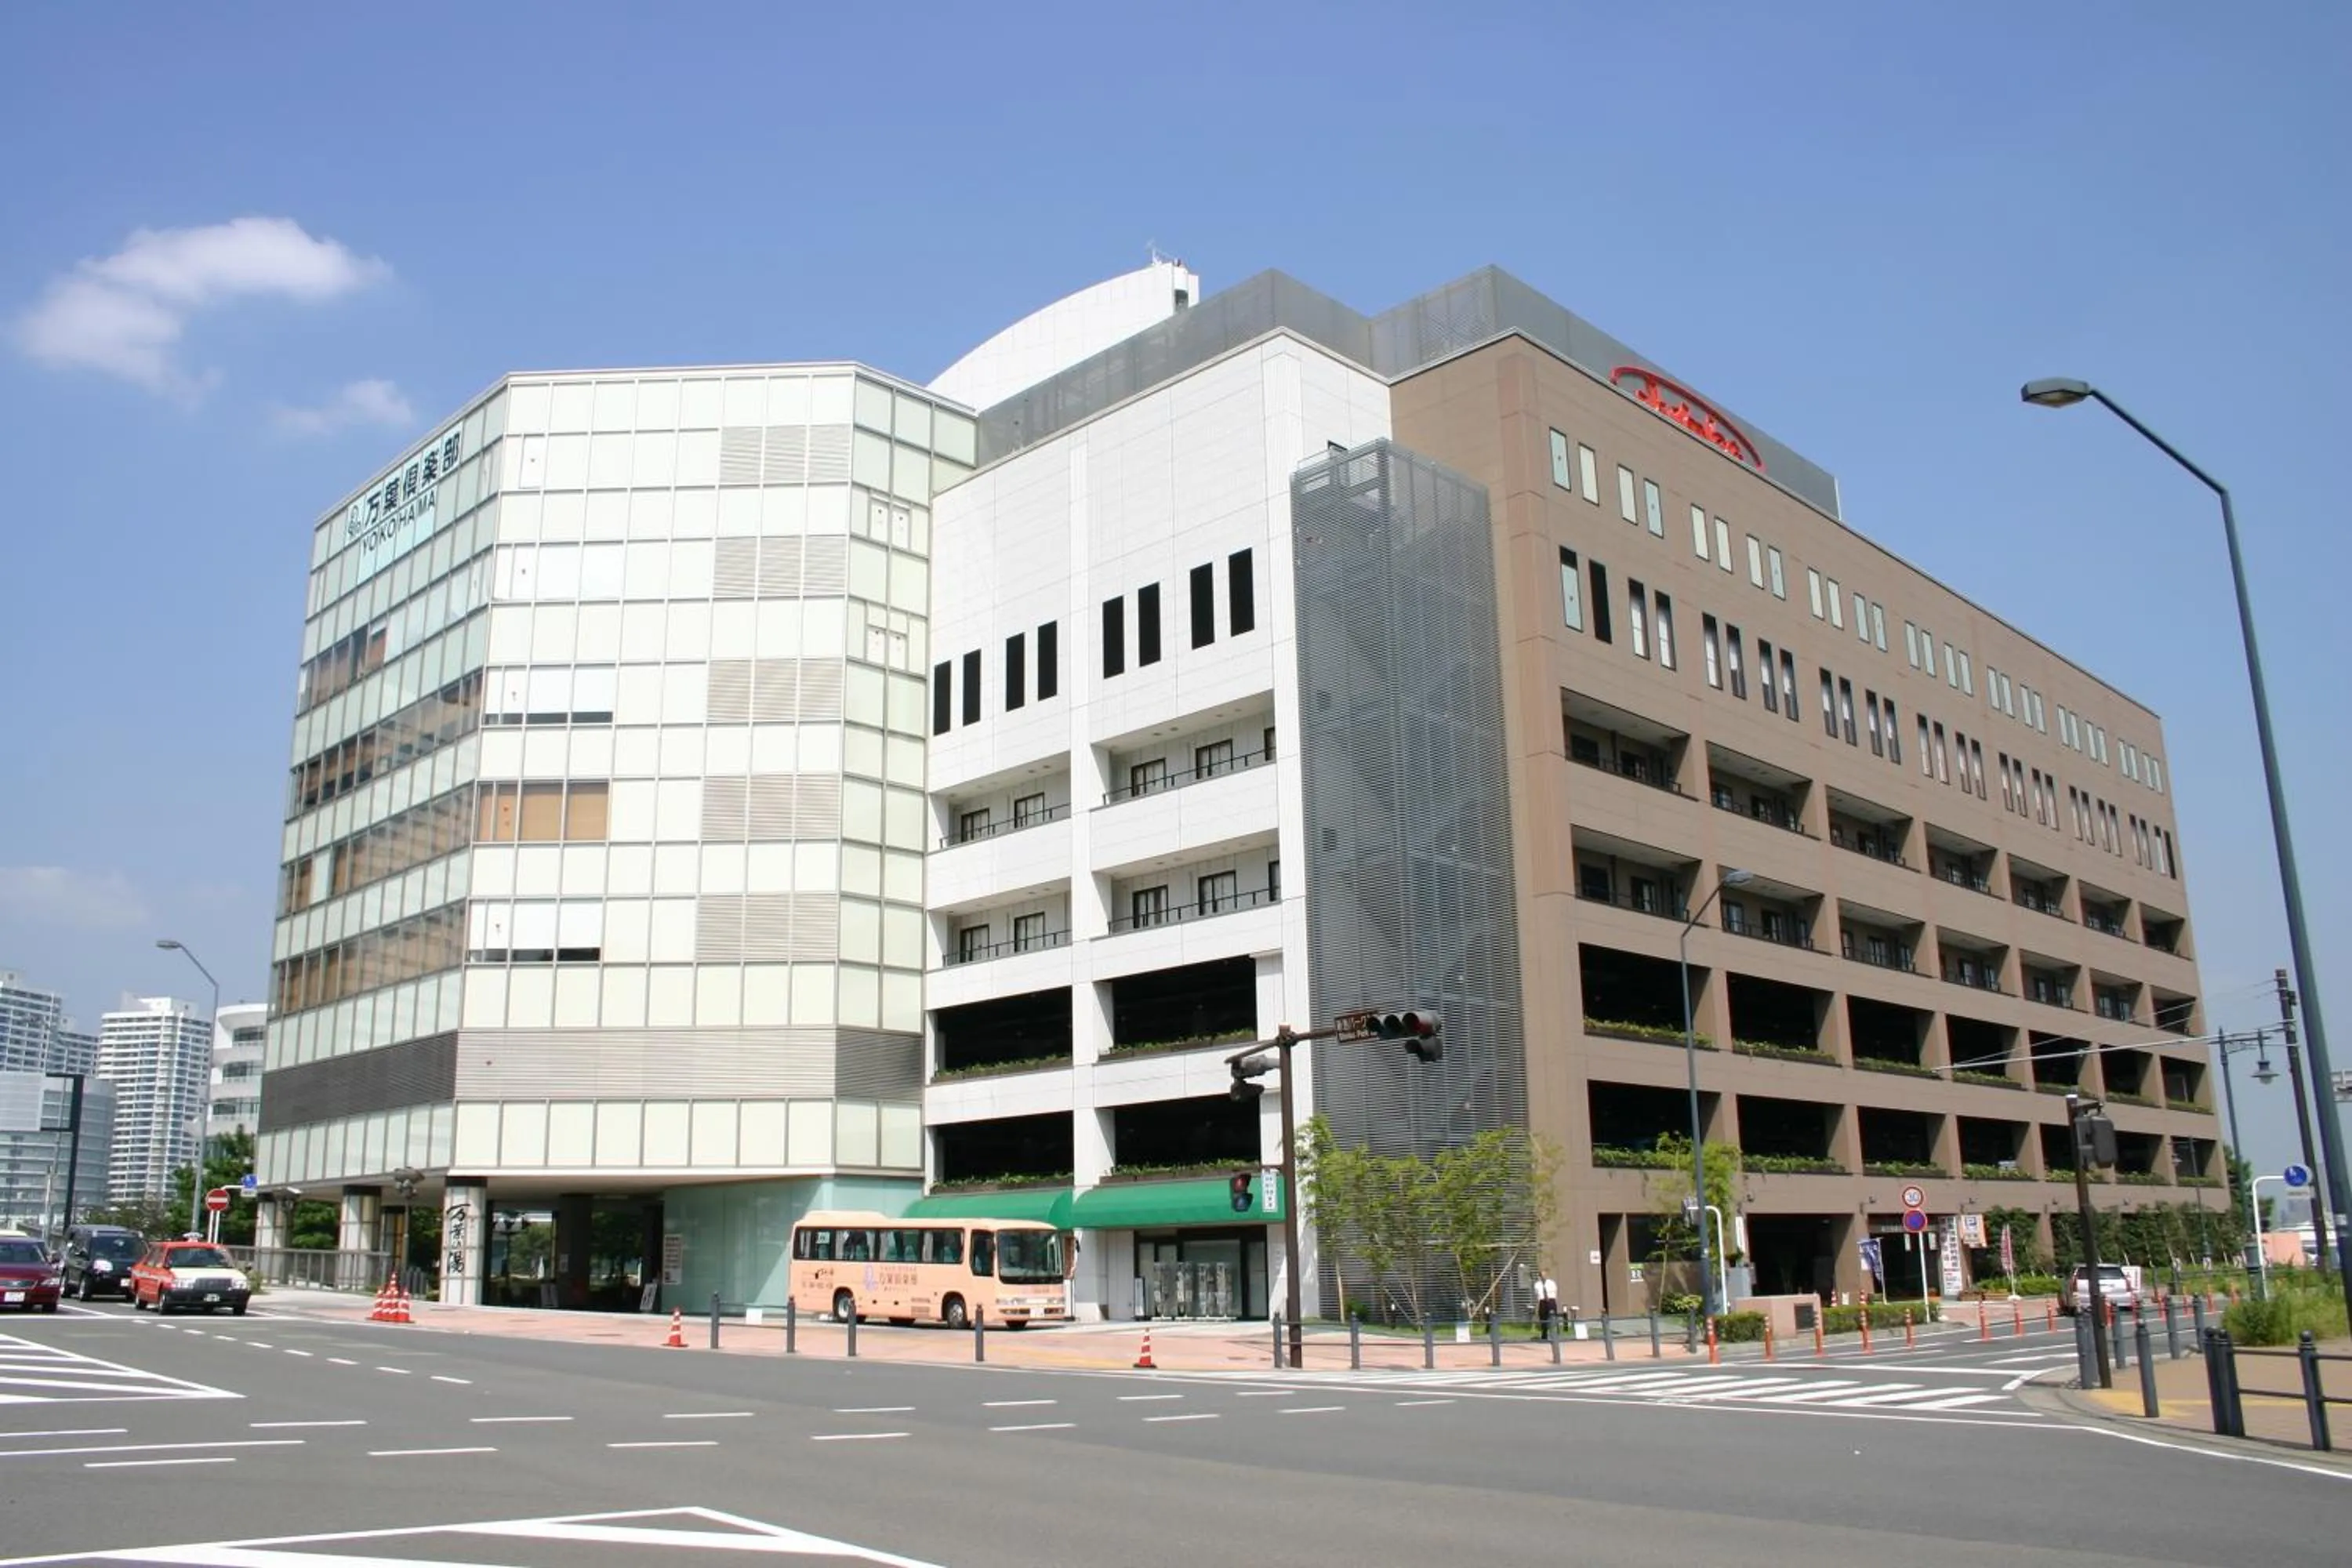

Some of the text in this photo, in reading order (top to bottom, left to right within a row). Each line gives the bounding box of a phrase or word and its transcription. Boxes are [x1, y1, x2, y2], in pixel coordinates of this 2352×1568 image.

[365, 432, 460, 526] 万葉倶楽部
[362, 491, 436, 555] YOKOHAMA
